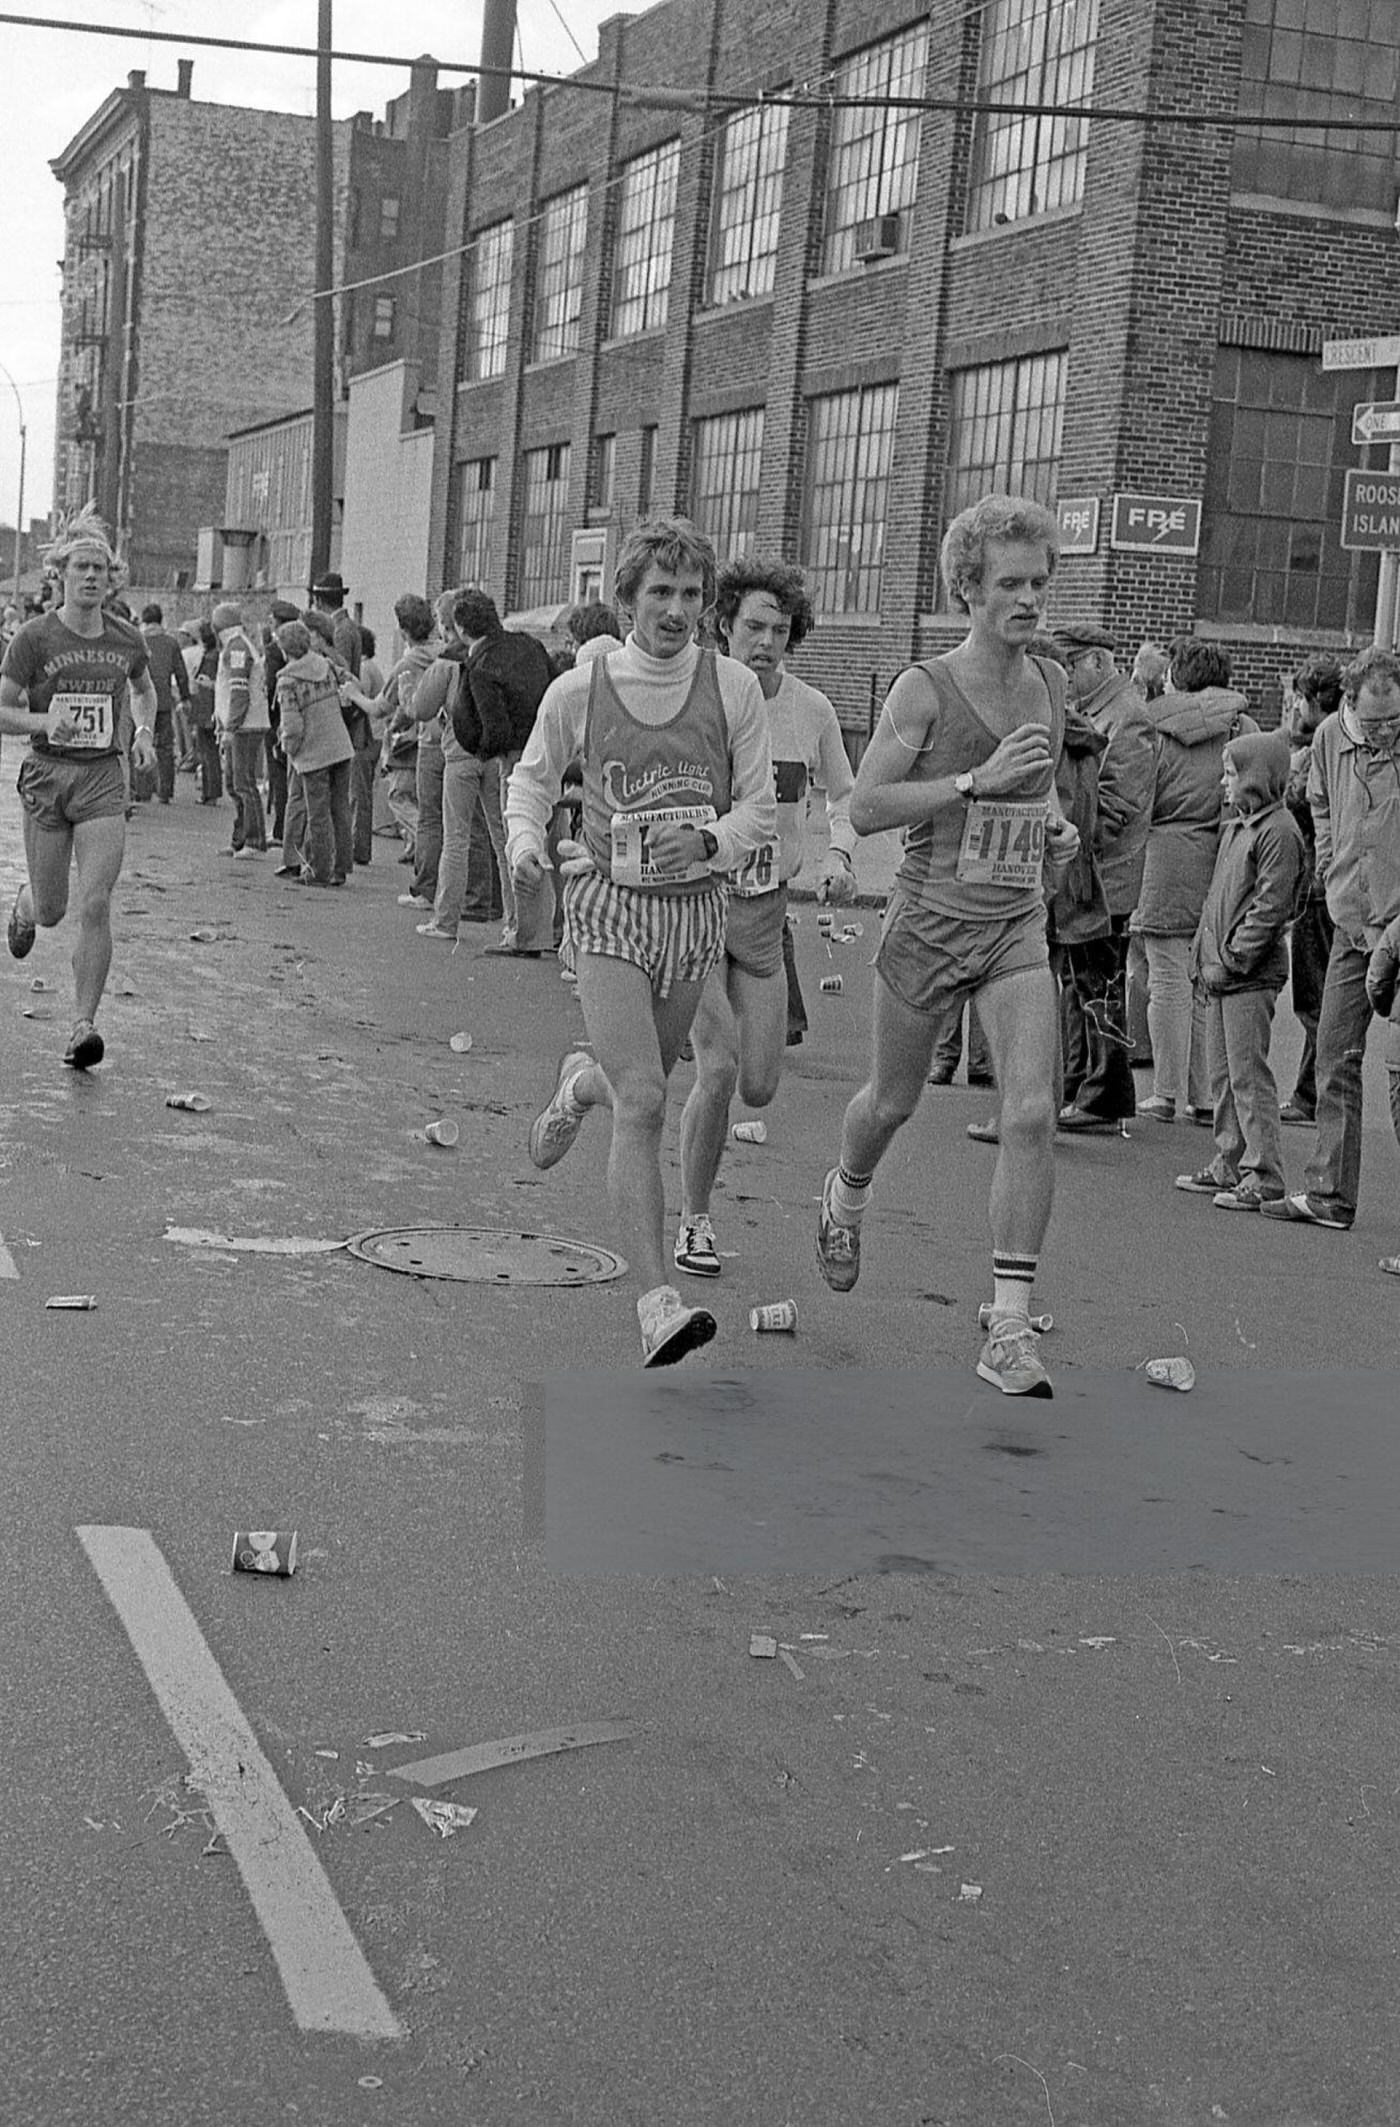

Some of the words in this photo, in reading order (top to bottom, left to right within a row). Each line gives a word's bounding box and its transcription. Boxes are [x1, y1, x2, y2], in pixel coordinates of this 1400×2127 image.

[1365, 414, 1385, 431] ONE
[1355, 484, 1400, 506] ROOS
[1128, 507, 1187, 532] FPE
[69, 705, 105, 734] 751
[602, 760, 673, 810] Electric
[651, 779, 690, 799] RUNNING
[980, 819, 1044, 863] 1149
